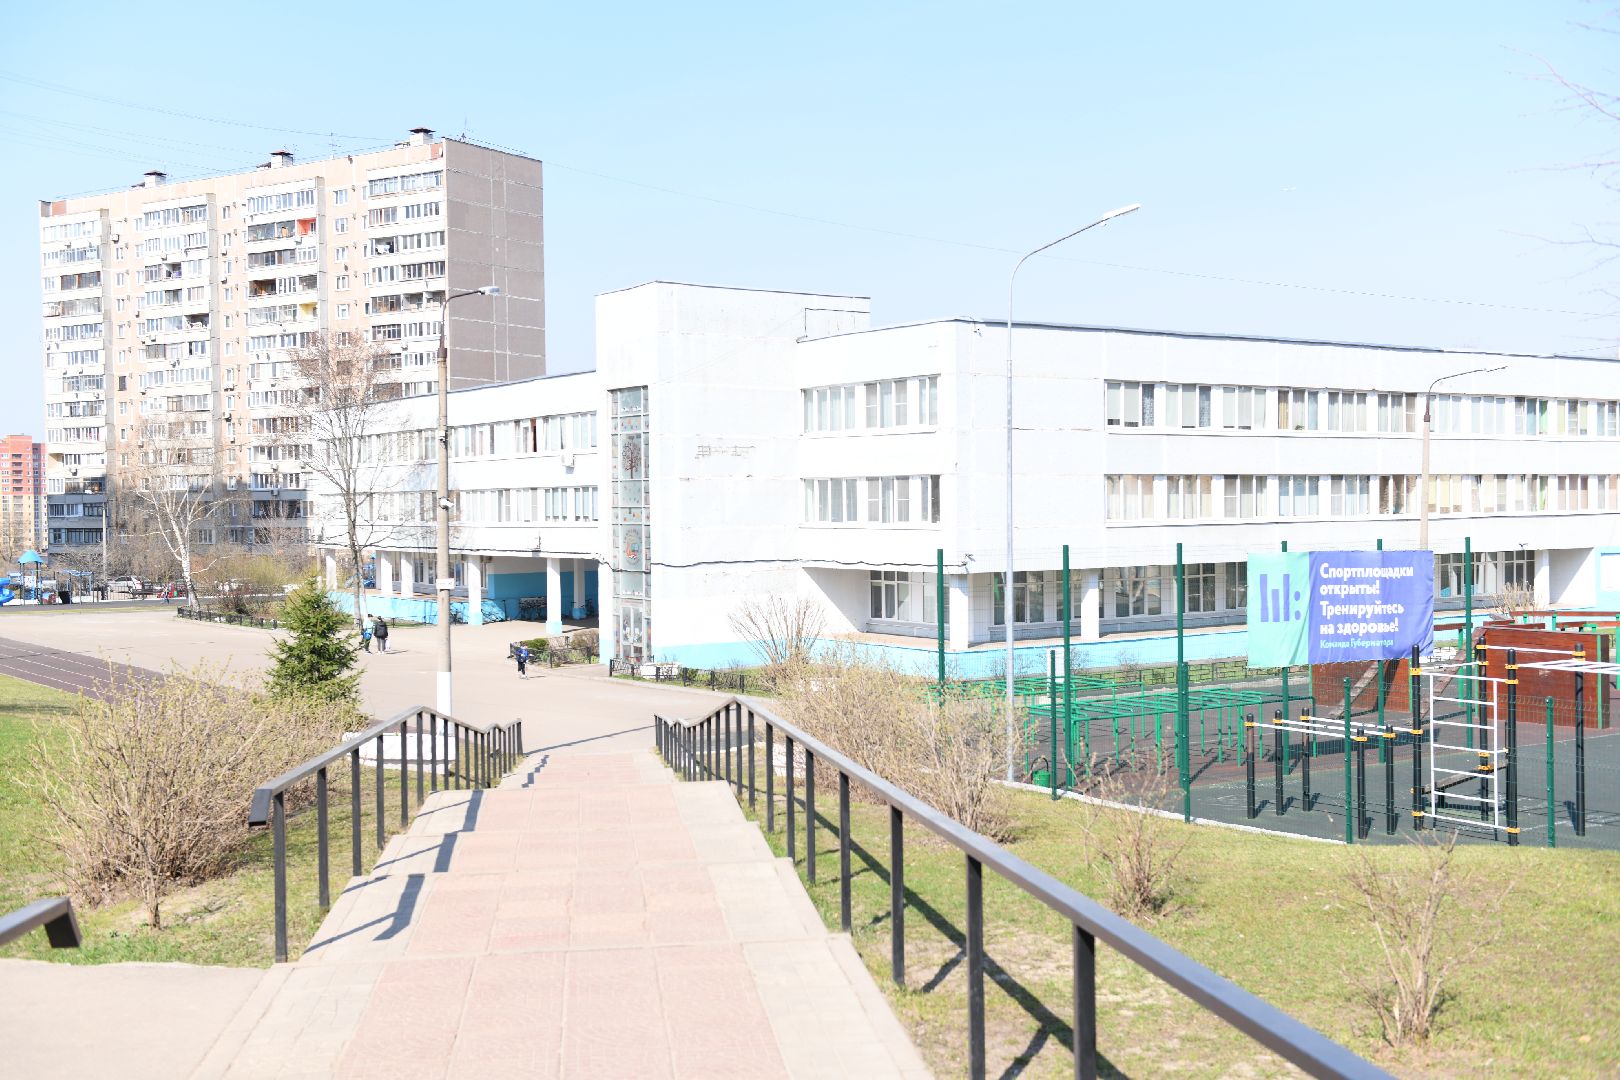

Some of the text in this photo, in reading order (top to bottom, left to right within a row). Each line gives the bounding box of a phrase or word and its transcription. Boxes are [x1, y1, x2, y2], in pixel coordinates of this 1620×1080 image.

[1320, 563, 1413, 581] Спортплощадки
[1320, 580, 1380, 598] открыты!
[1320, 600, 1405, 620] Тренируйтесь
[1320, 617, 1399, 636] на здоровье!
[1320, 638, 1394, 649] Команда Губернатора
